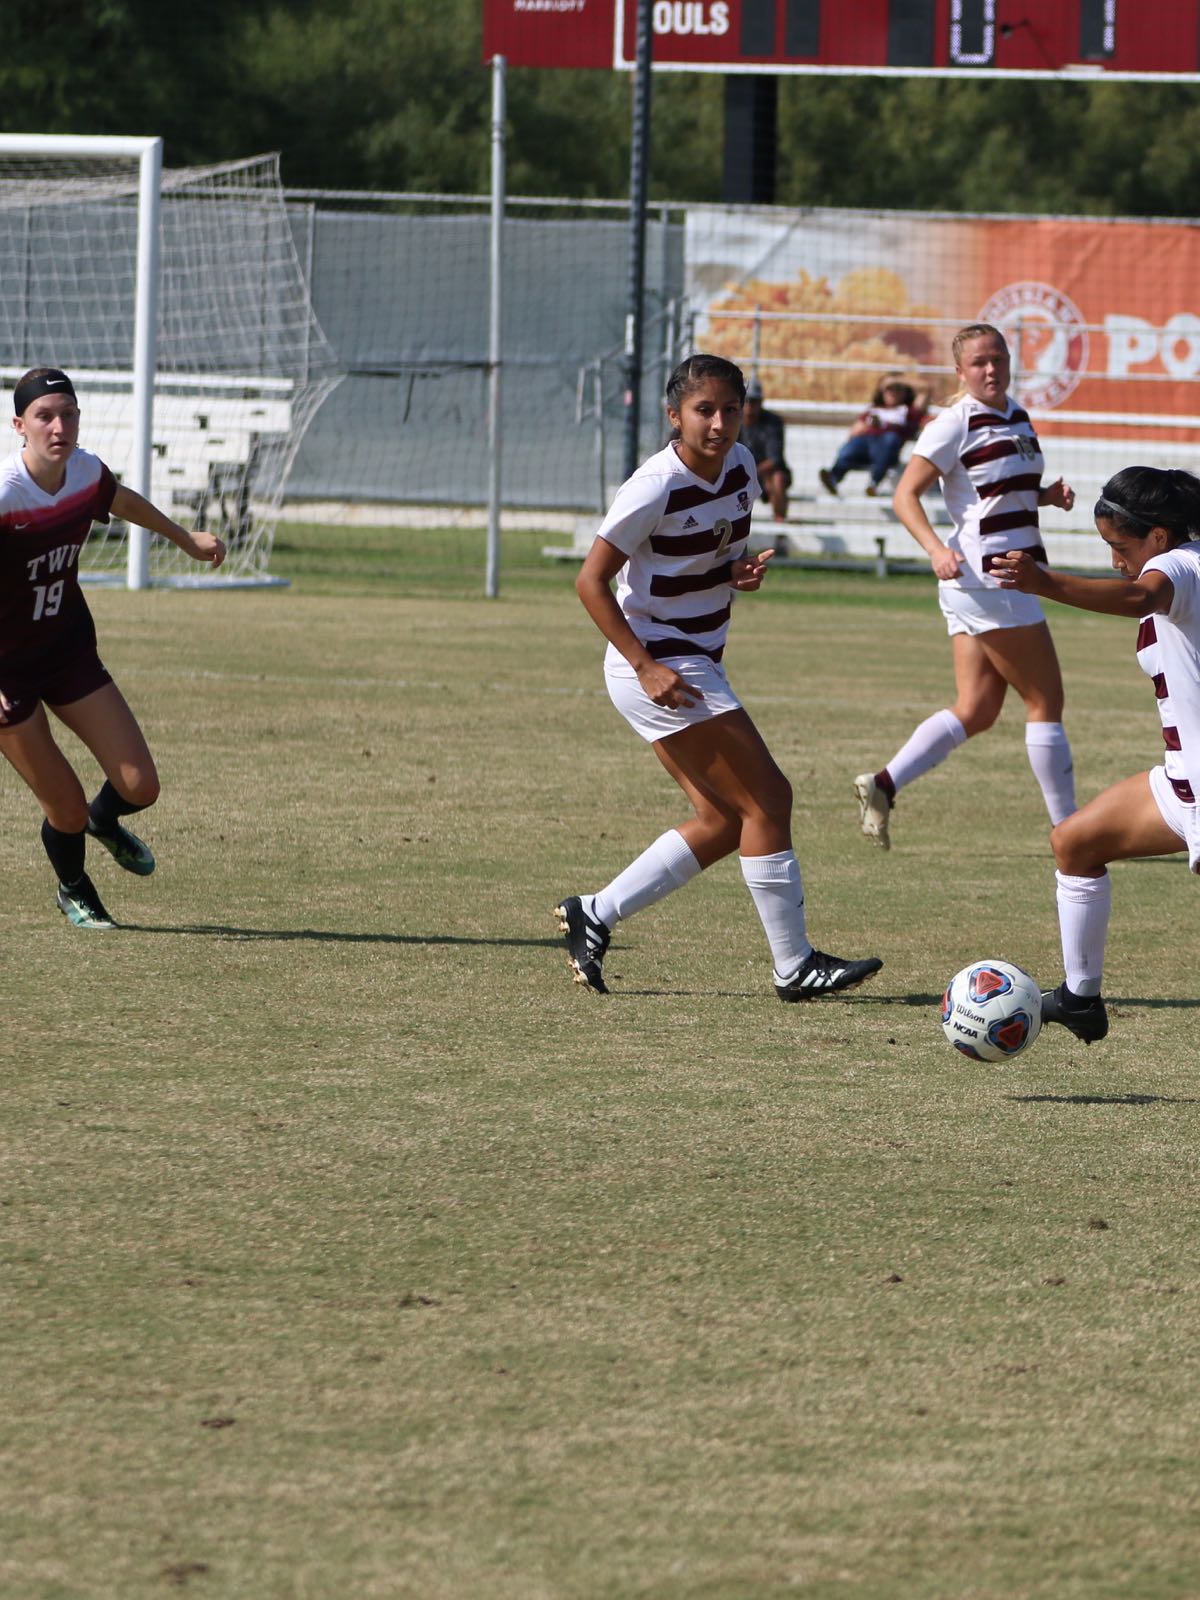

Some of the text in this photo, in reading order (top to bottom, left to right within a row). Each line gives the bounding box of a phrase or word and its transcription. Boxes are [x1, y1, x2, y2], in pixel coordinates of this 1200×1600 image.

[653, 0, 730, 36] OULS
[712, 518, 733, 559] 2
[32, 579, 65, 621] 19
[953, 1021, 978, 1039] NCAA
[956, 1003, 986, 1024] Wilson
